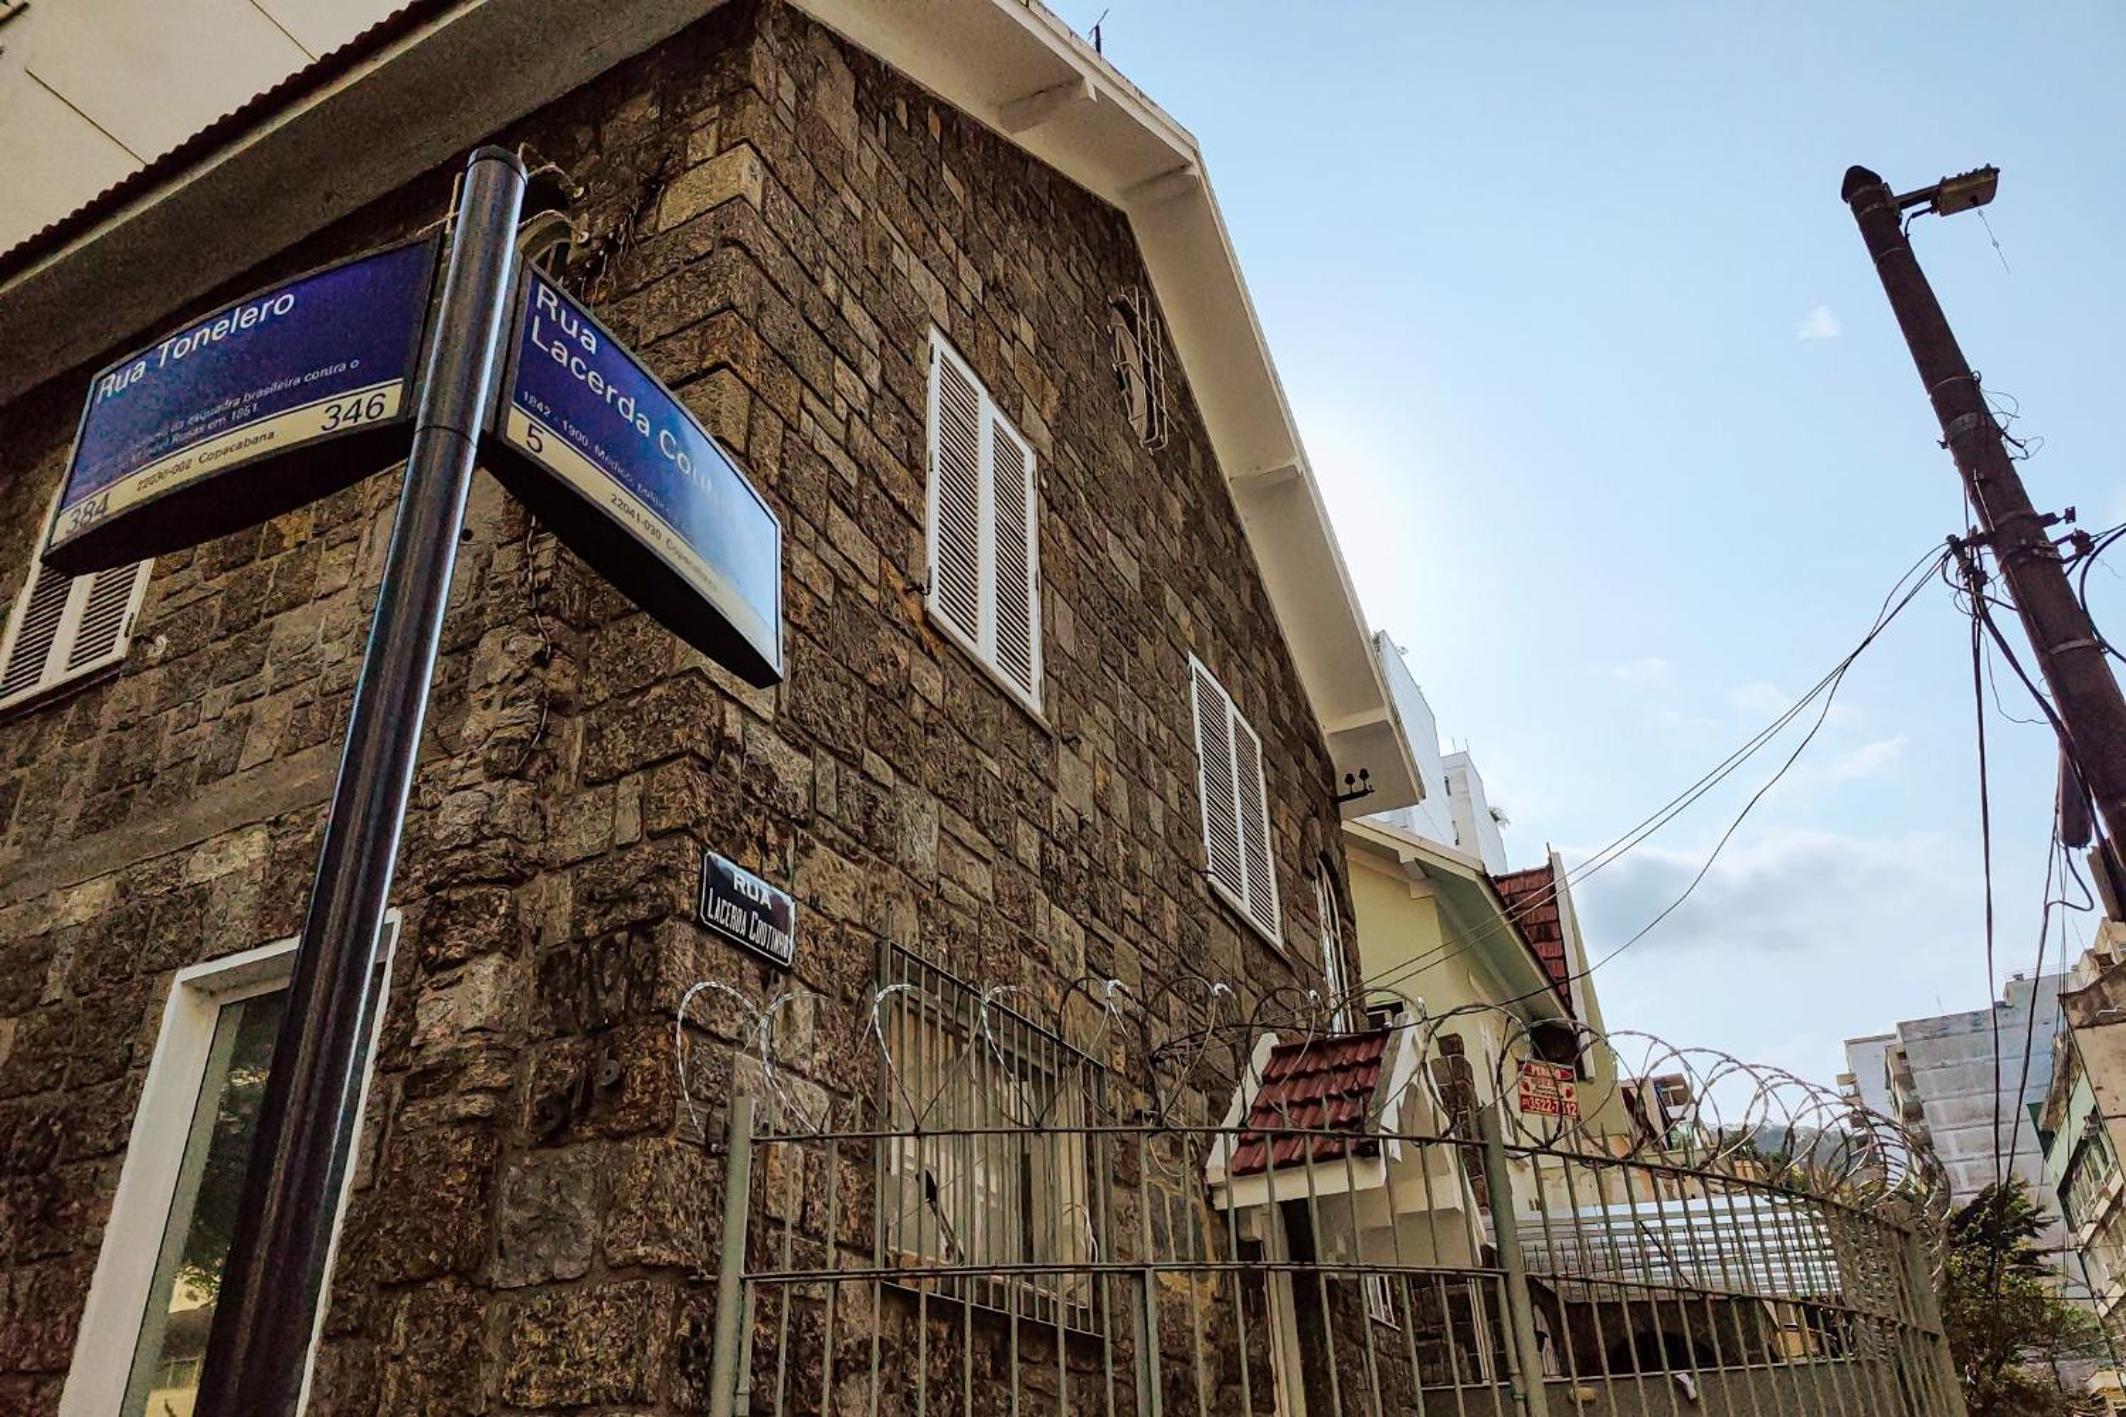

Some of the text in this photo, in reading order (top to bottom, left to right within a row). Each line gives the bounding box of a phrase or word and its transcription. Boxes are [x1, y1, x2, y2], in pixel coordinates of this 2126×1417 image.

[97, 294, 295, 403] Rua Tonelero
[537, 283, 597, 355] Rua
[243, 376, 302, 402] brasileira
[304, 362, 347, 382] contra
[350, 359, 360, 369] o
[532, 315, 650, 438] Lacerda
[66, 493, 110, 532] 384
[198, 431, 275, 464] Copacabana
[321, 393, 387, 433] 346
[526, 423, 544, 453] 5
[707, 887, 747, 937] LACERDA
[733, 871, 772, 910] RUA
